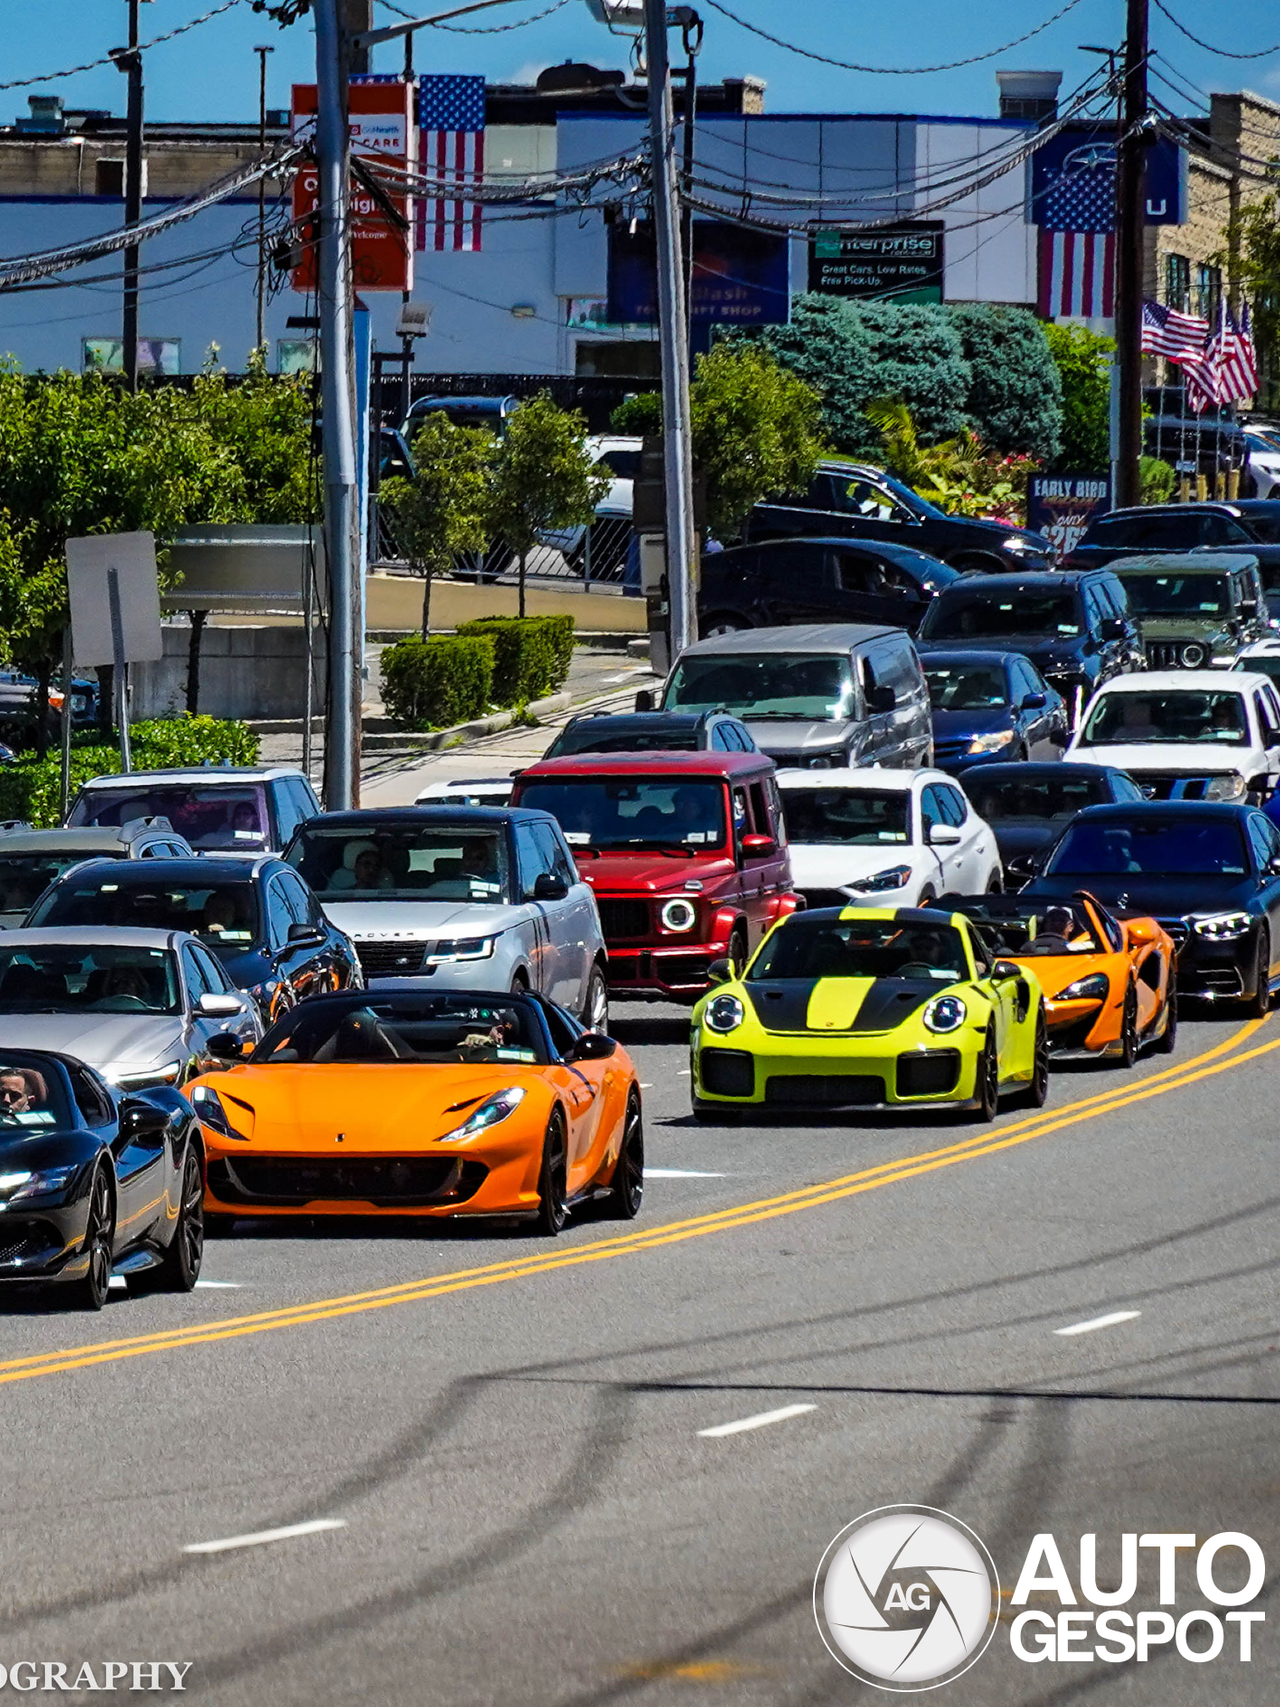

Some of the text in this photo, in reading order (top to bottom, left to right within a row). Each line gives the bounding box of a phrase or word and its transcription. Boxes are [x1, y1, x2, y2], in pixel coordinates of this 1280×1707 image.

[363, 138, 400, 148] CARE
[822, 265, 848, 274] Great
[1034, 479, 1107, 498] EARLY BIRD
